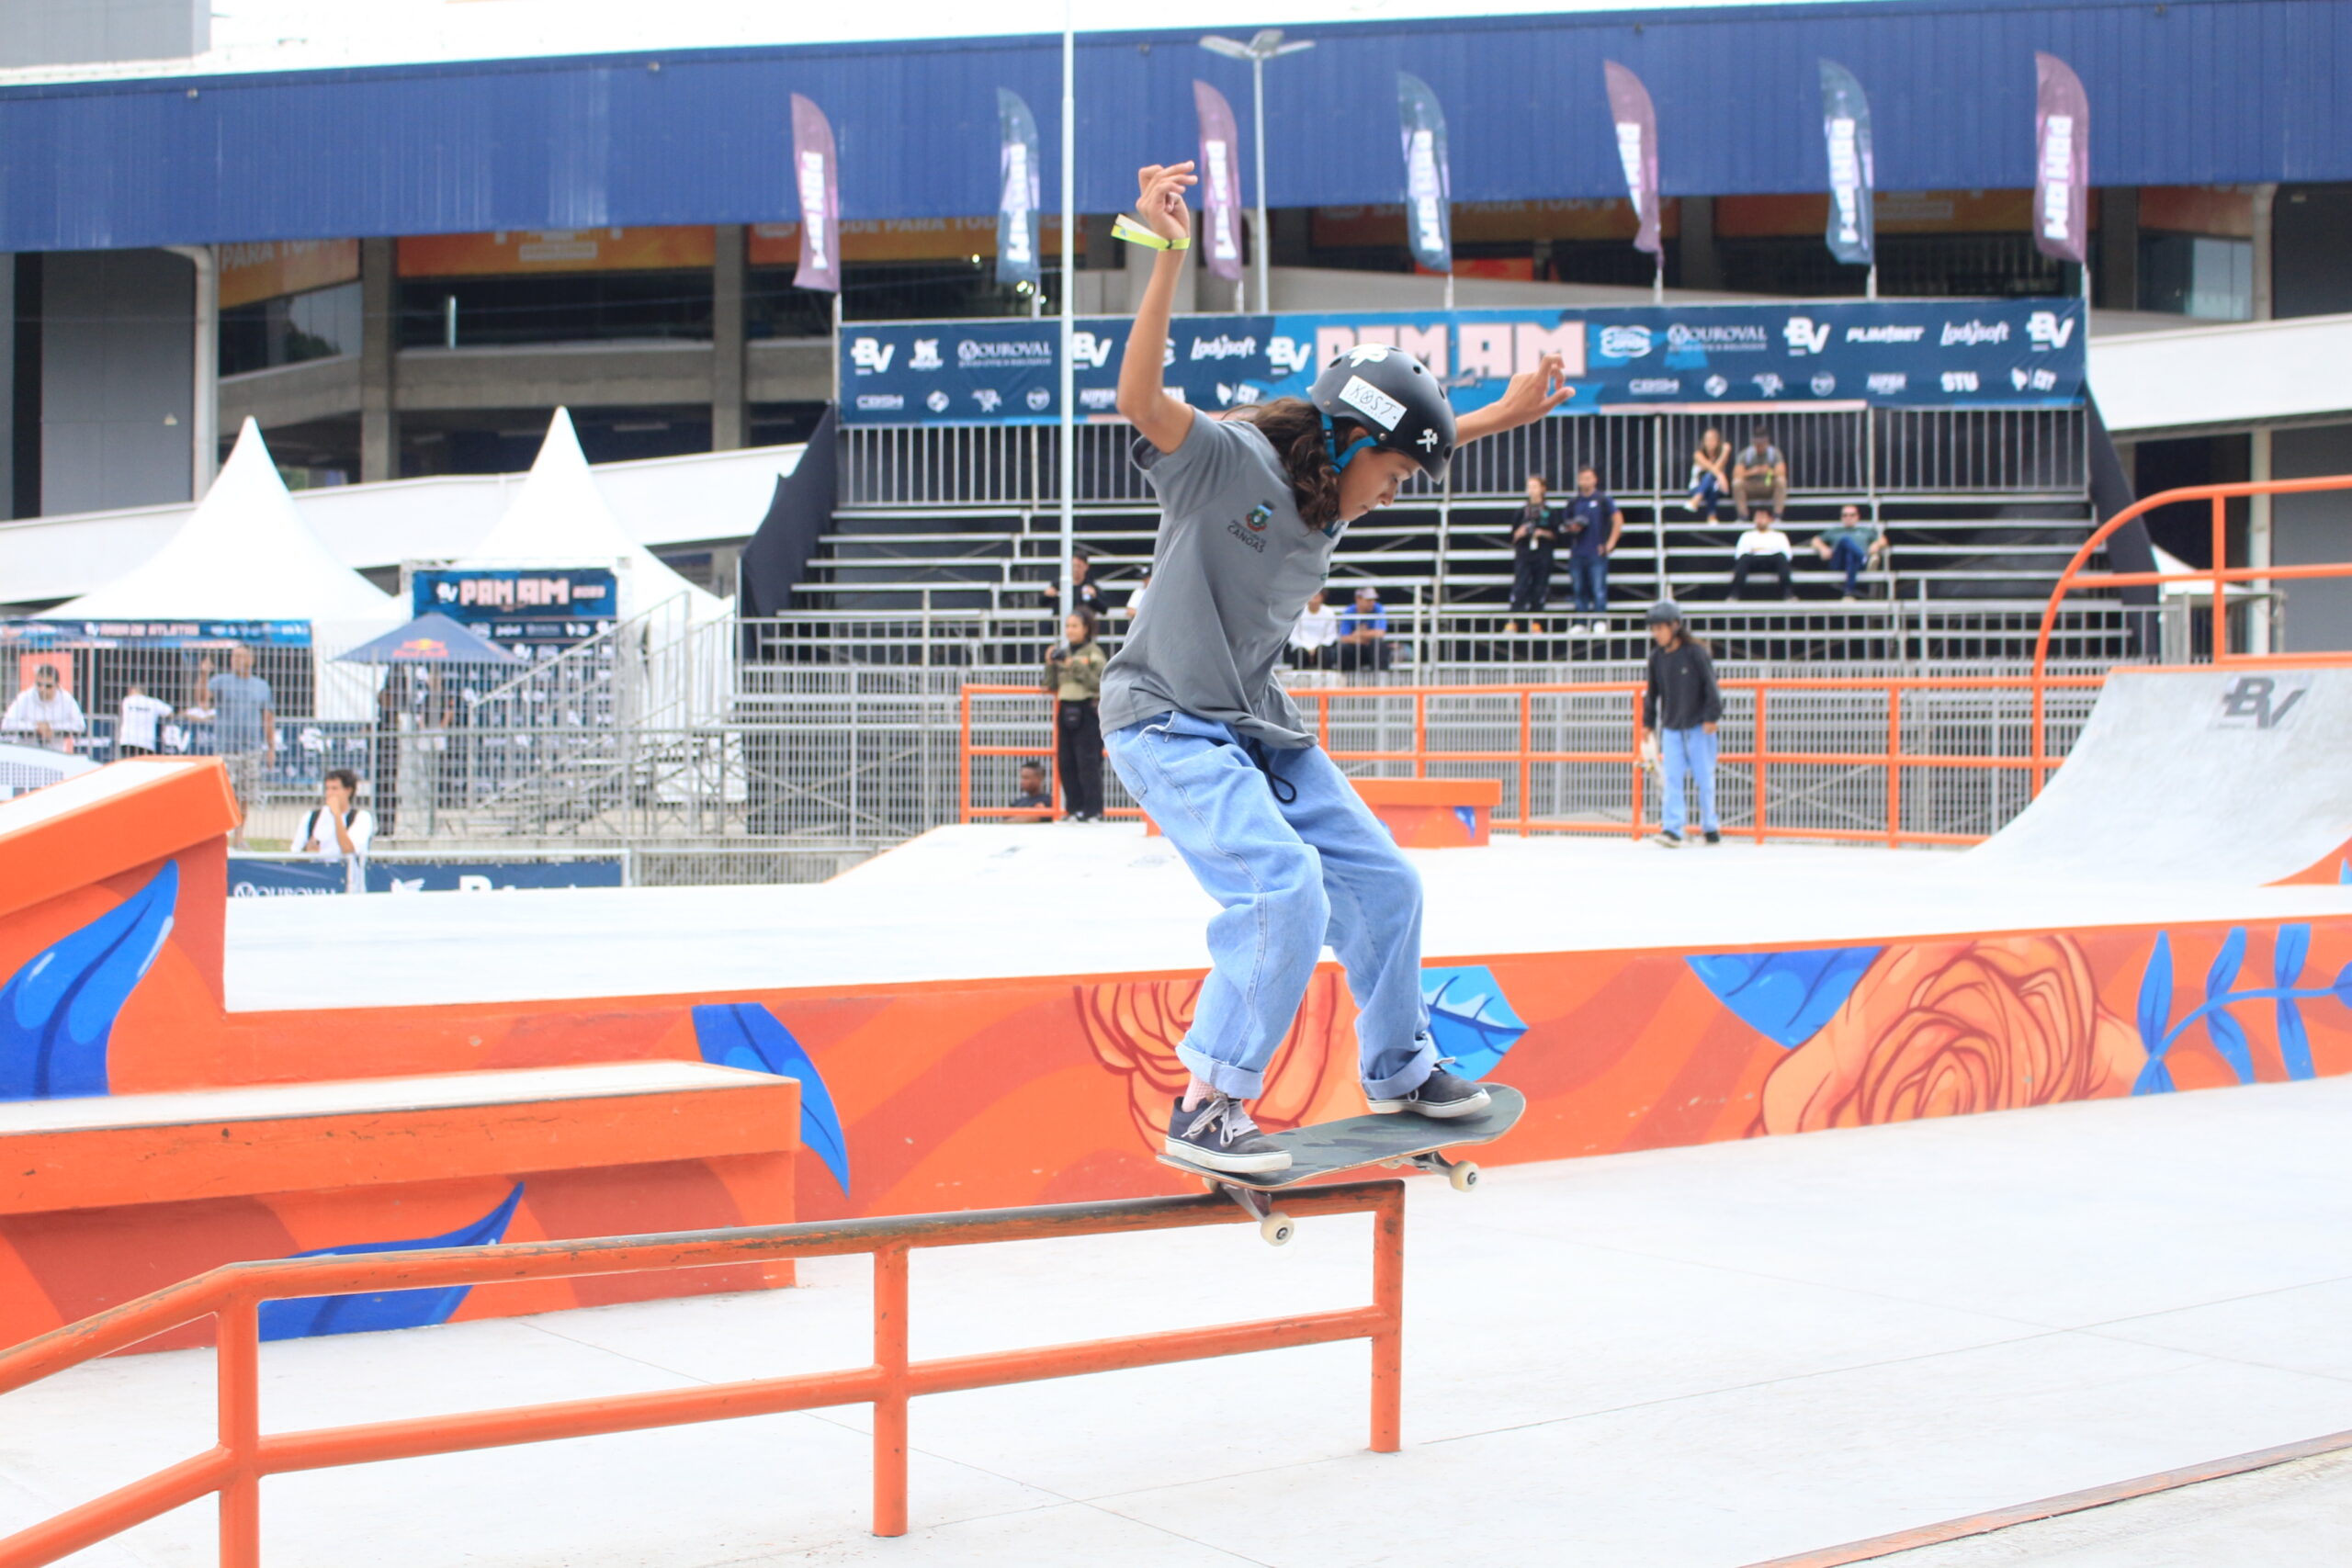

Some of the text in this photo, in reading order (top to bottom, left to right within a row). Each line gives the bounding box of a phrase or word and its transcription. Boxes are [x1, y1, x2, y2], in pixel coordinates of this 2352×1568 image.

[2044, 180, 2069, 239] AM
[1782, 317, 1831, 354] BV
[2026, 311, 2075, 348] BV
[1265, 336, 1312, 372] BV
[1458, 321, 1586, 378] AM
[1940, 371, 1978, 392] STU
[1227, 525, 1265, 553] CANOAS
[460, 580, 514, 606] PAM
[516, 578, 570, 605] AM
